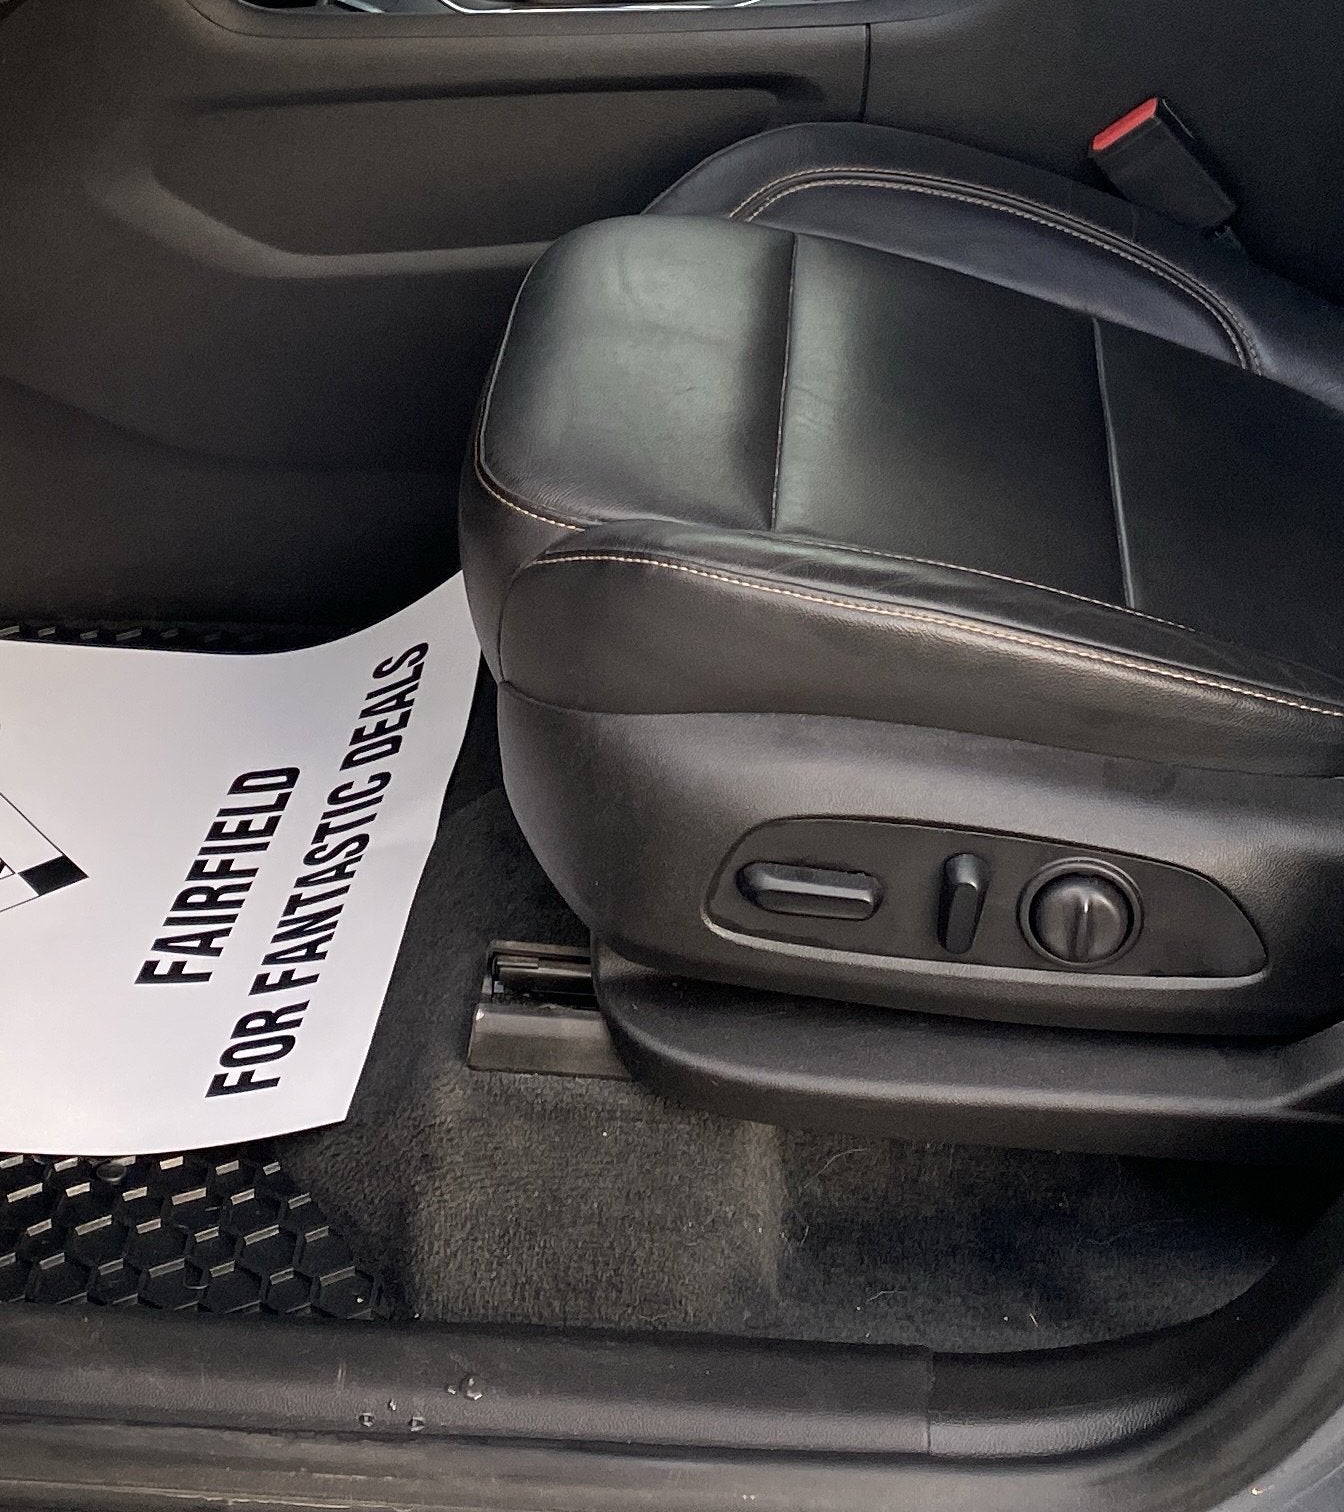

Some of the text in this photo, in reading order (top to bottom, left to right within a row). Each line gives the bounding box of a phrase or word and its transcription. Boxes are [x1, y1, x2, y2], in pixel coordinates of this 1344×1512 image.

[134, 766, 301, 985] FAIRFIELD
[205, 642, 430, 1098] FOR FANTASTIC DEALS
